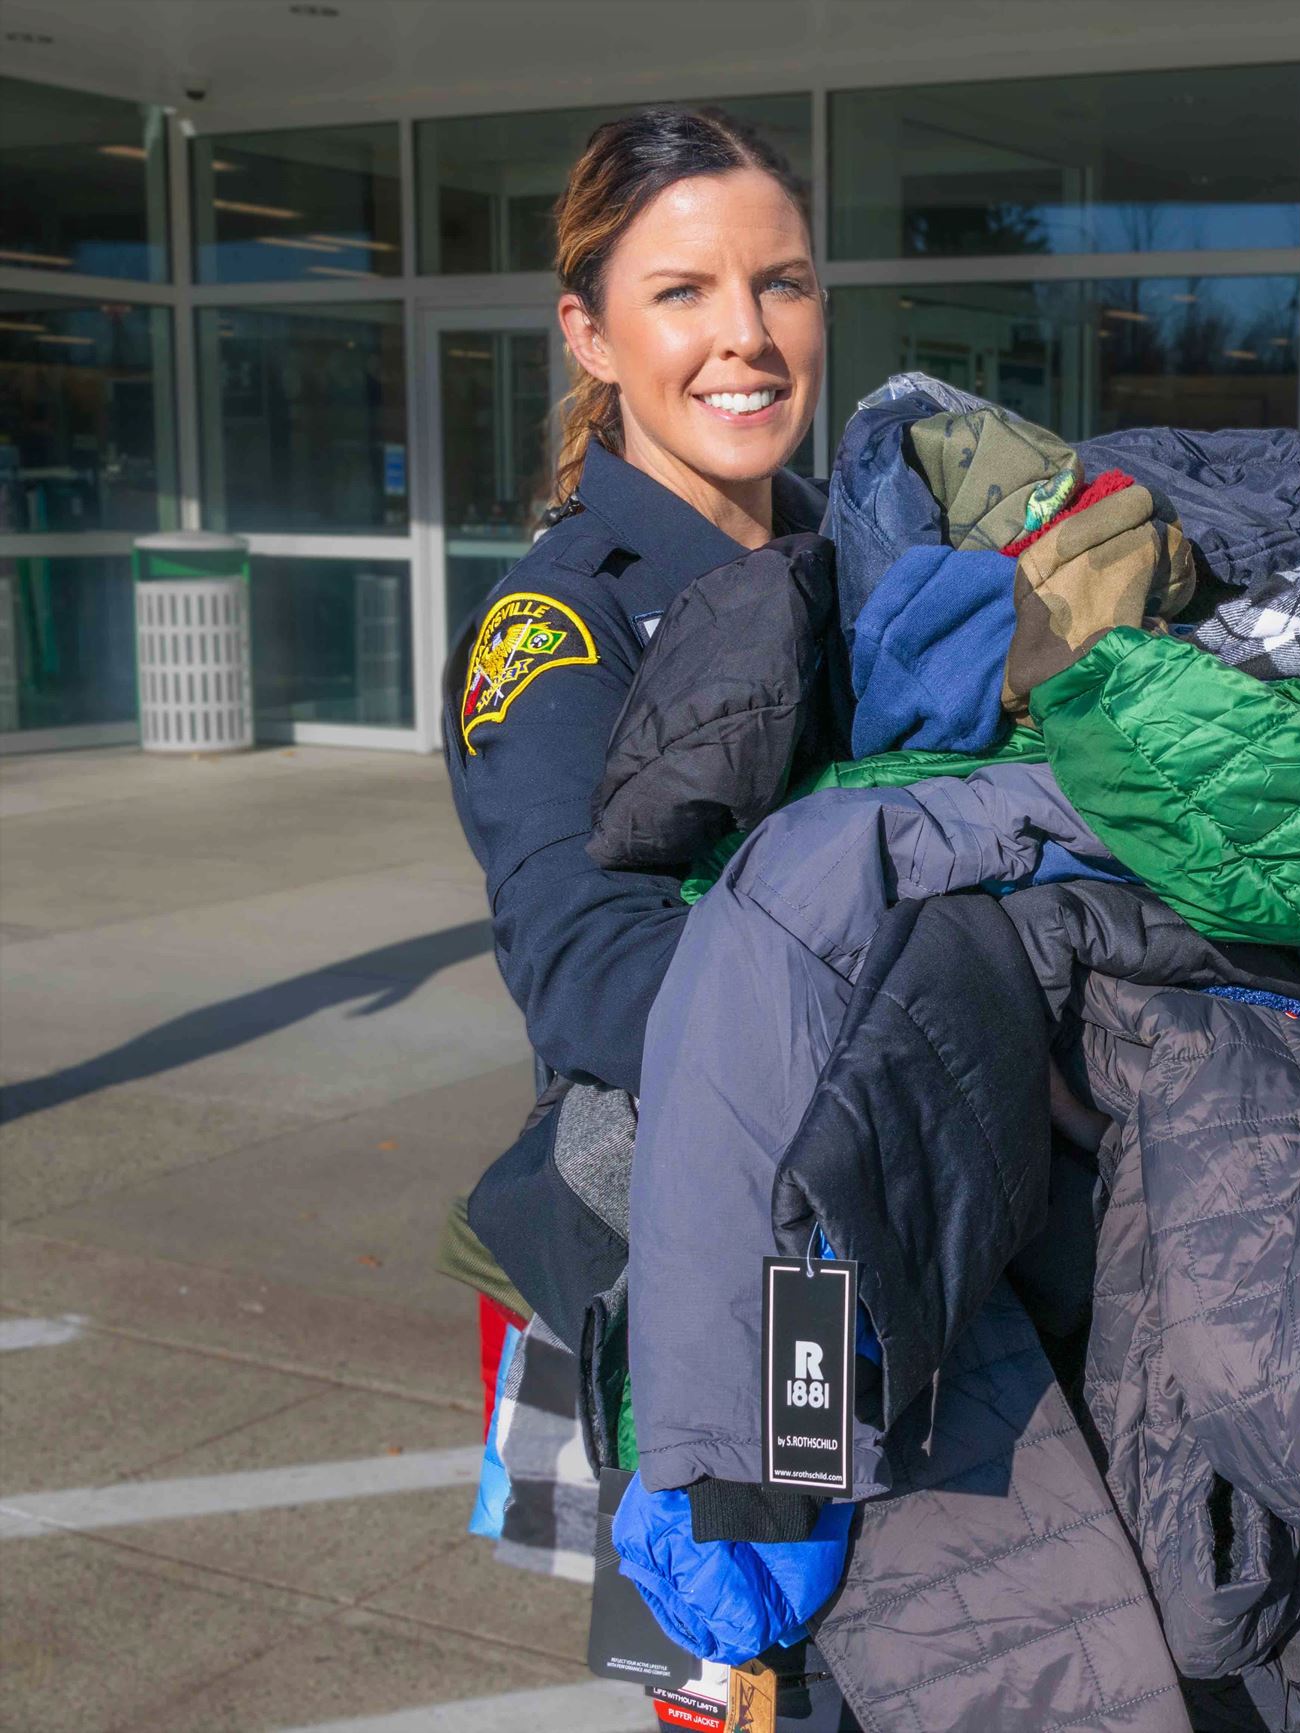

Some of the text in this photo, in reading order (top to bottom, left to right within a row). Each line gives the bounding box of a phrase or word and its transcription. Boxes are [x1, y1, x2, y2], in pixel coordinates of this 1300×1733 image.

[795, 1340, 825, 1380] R
[786, 1380, 830, 1409] 1881
[777, 1435, 838, 1451] by S.ROTHSCHILD
[774, 1469, 843, 1481] www.srothschild.com
[653, 1687, 719, 1713] LIFE WITHOUT LIMITS
[668, 1708, 720, 1729] PUFFER JACKET
